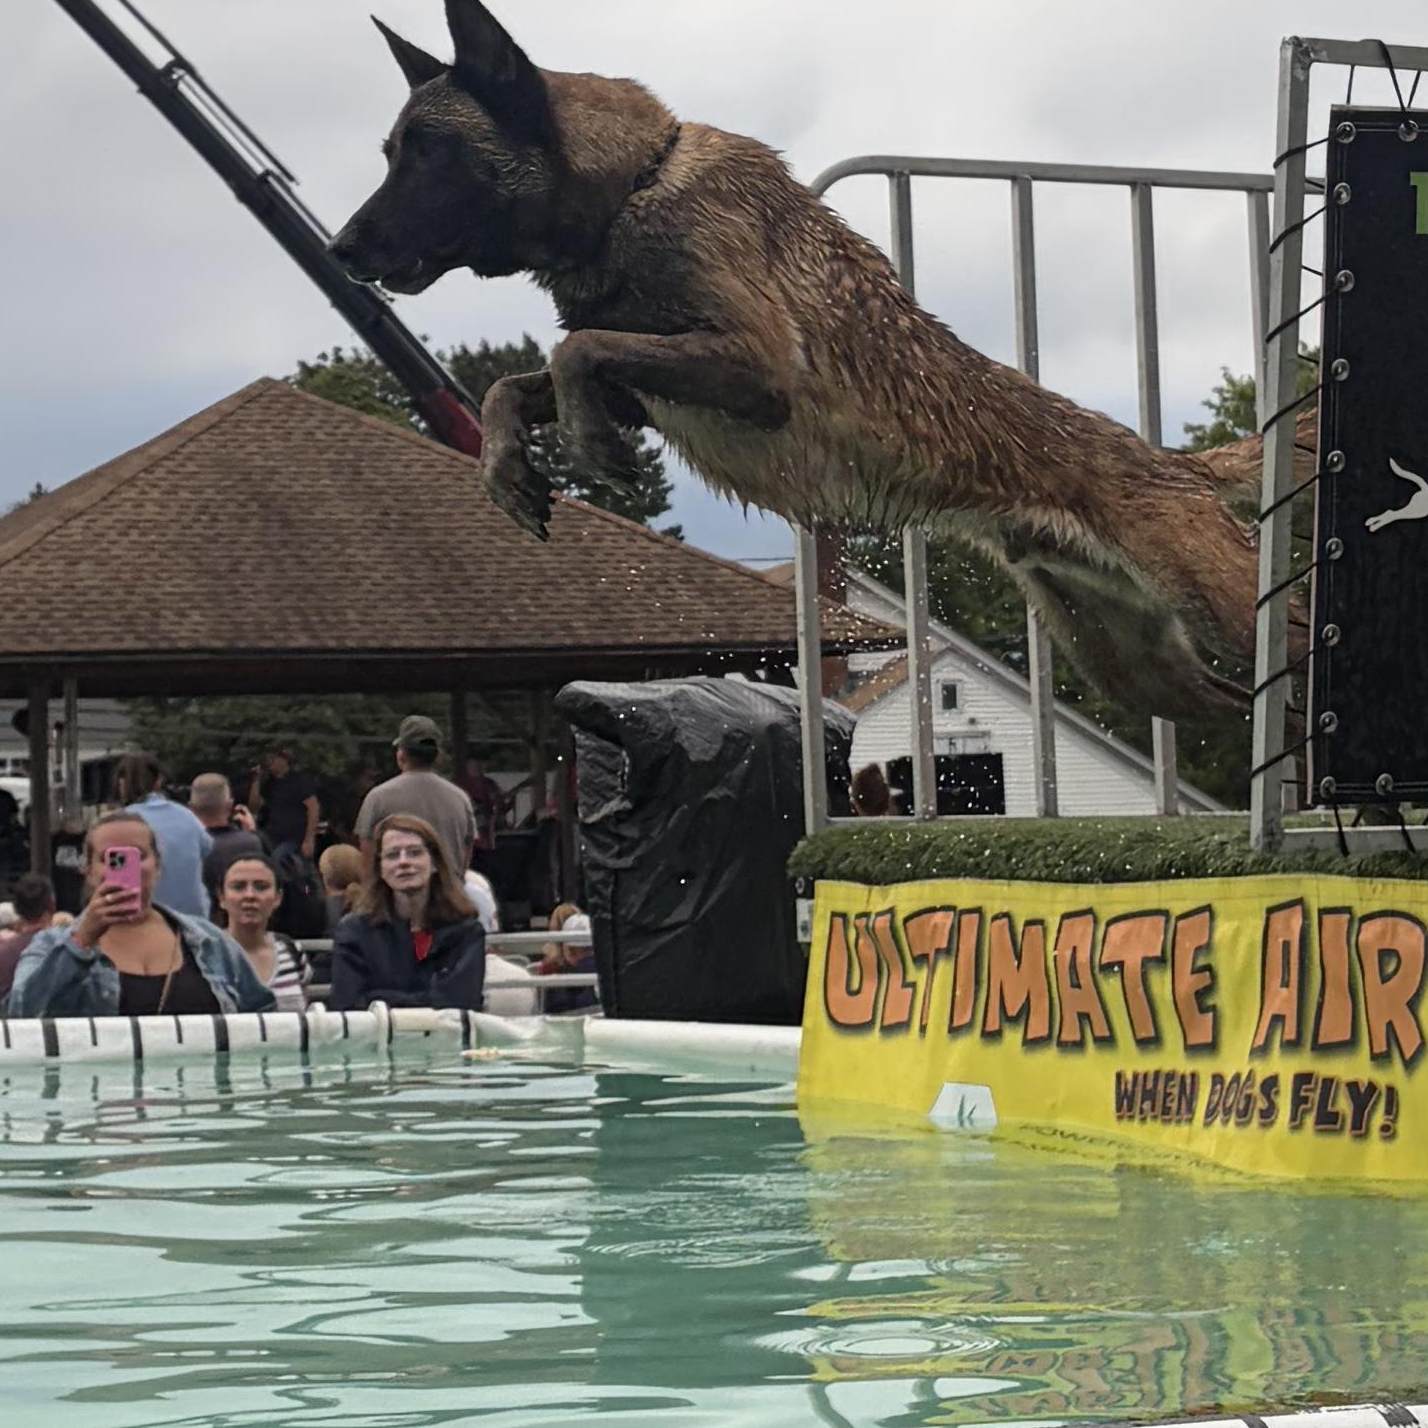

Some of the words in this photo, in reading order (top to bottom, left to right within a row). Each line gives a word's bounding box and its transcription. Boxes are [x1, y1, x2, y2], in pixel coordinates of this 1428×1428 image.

[824, 903, 1218, 1056] ULTIMATE
[1249, 896, 1428, 1068] AIR
[1115, 1070, 1198, 1123] WHEN
[1203, 1070, 1278, 1127] DOGS
[1288, 1071, 1398, 1140] FLY!
